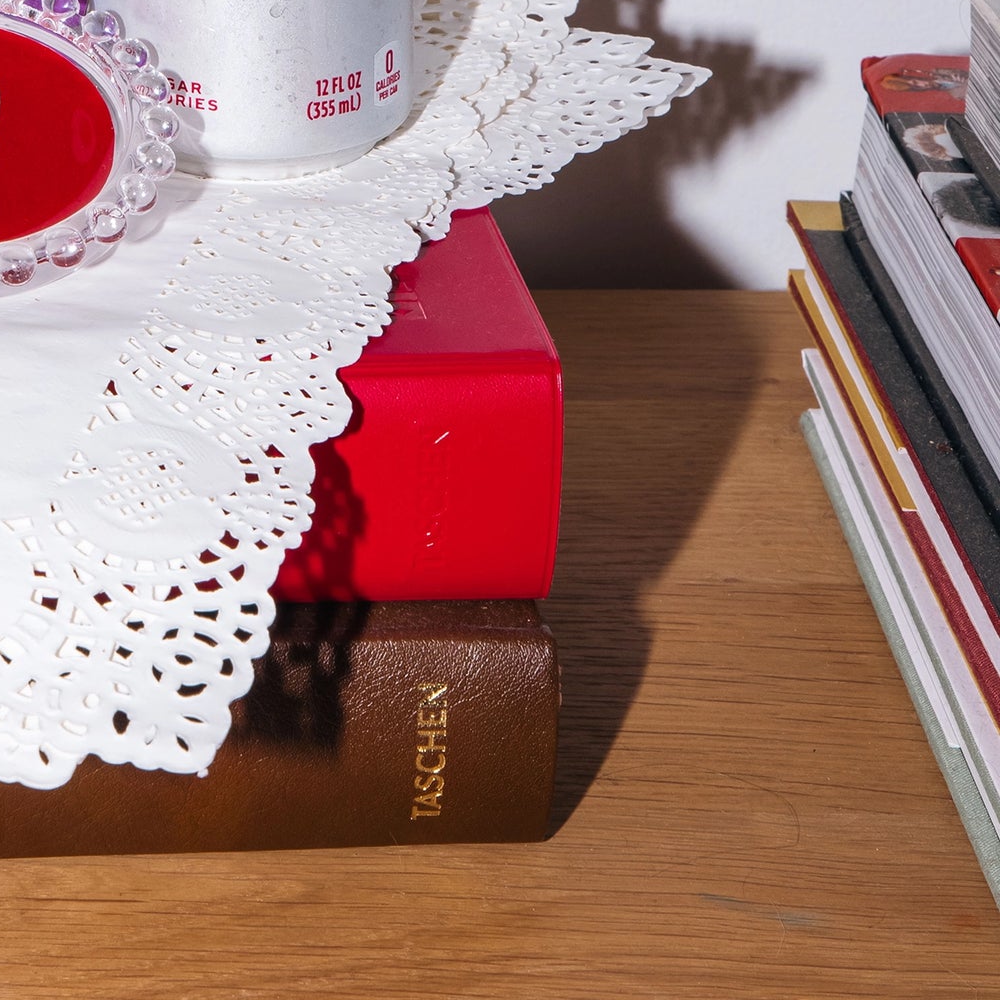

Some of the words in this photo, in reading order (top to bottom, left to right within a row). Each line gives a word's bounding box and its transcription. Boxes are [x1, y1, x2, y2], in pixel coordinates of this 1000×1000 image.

[385, 49, 394, 74] 0
[316, 79, 329, 97] 12
[332, 76, 345, 95] FL
[347, 71, 362, 91] OZ
[375, 70, 401, 92] CALORIES
[306, 100, 336, 121] (355
[338, 92, 361, 115] mL)
[379, 89, 389, 101] PER
[410, 682, 448, 821] TASCHEN
